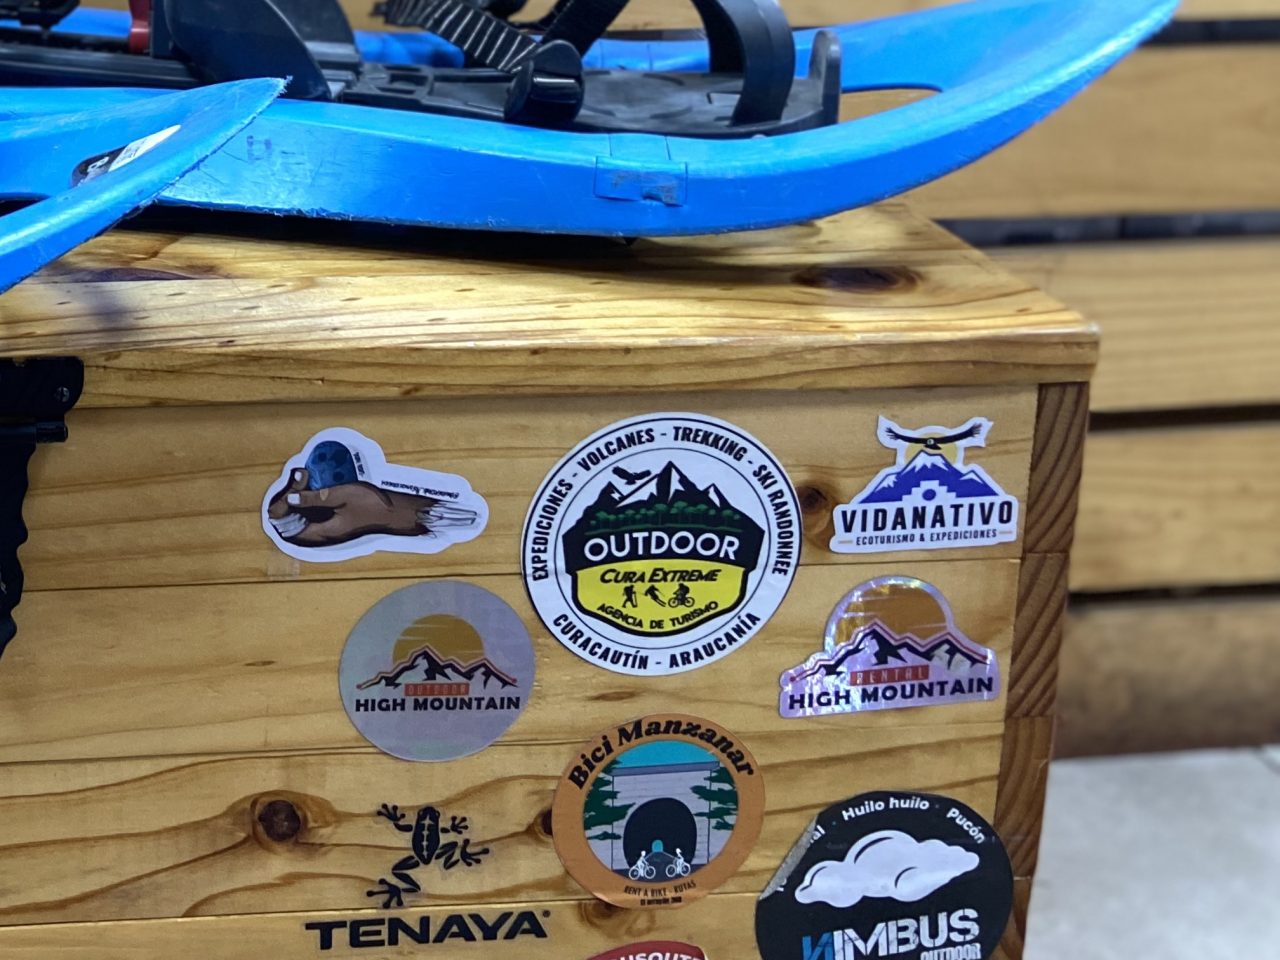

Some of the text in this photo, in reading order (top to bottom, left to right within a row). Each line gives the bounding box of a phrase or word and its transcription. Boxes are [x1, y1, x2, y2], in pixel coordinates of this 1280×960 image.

[531, 426, 794, 581] EXPEDICIONES VOLCANES TREKKING SKI RANDONNEE
[841, 501, 1013, 533] VIDANATIVO
[584, 531, 740, 561] OUTDOOR
[856, 529, 997, 546] ECOTURISMO & EXPEDICIONES
[597, 601, 719, 629] AGENCIA DE TURISMO
[553, 610, 761, 670] CURACAUTÍN ARAUCANÍA
[855, 668, 925, 685] RENTAL
[355, 696, 520, 712] HIGH MOUNTAIN
[788, 677, 993, 710] HIGH MOUNTAIN
[568, 719, 754, 790] Bici Manzanar
[842, 796, 985, 844] Huilo huilo Pucón
